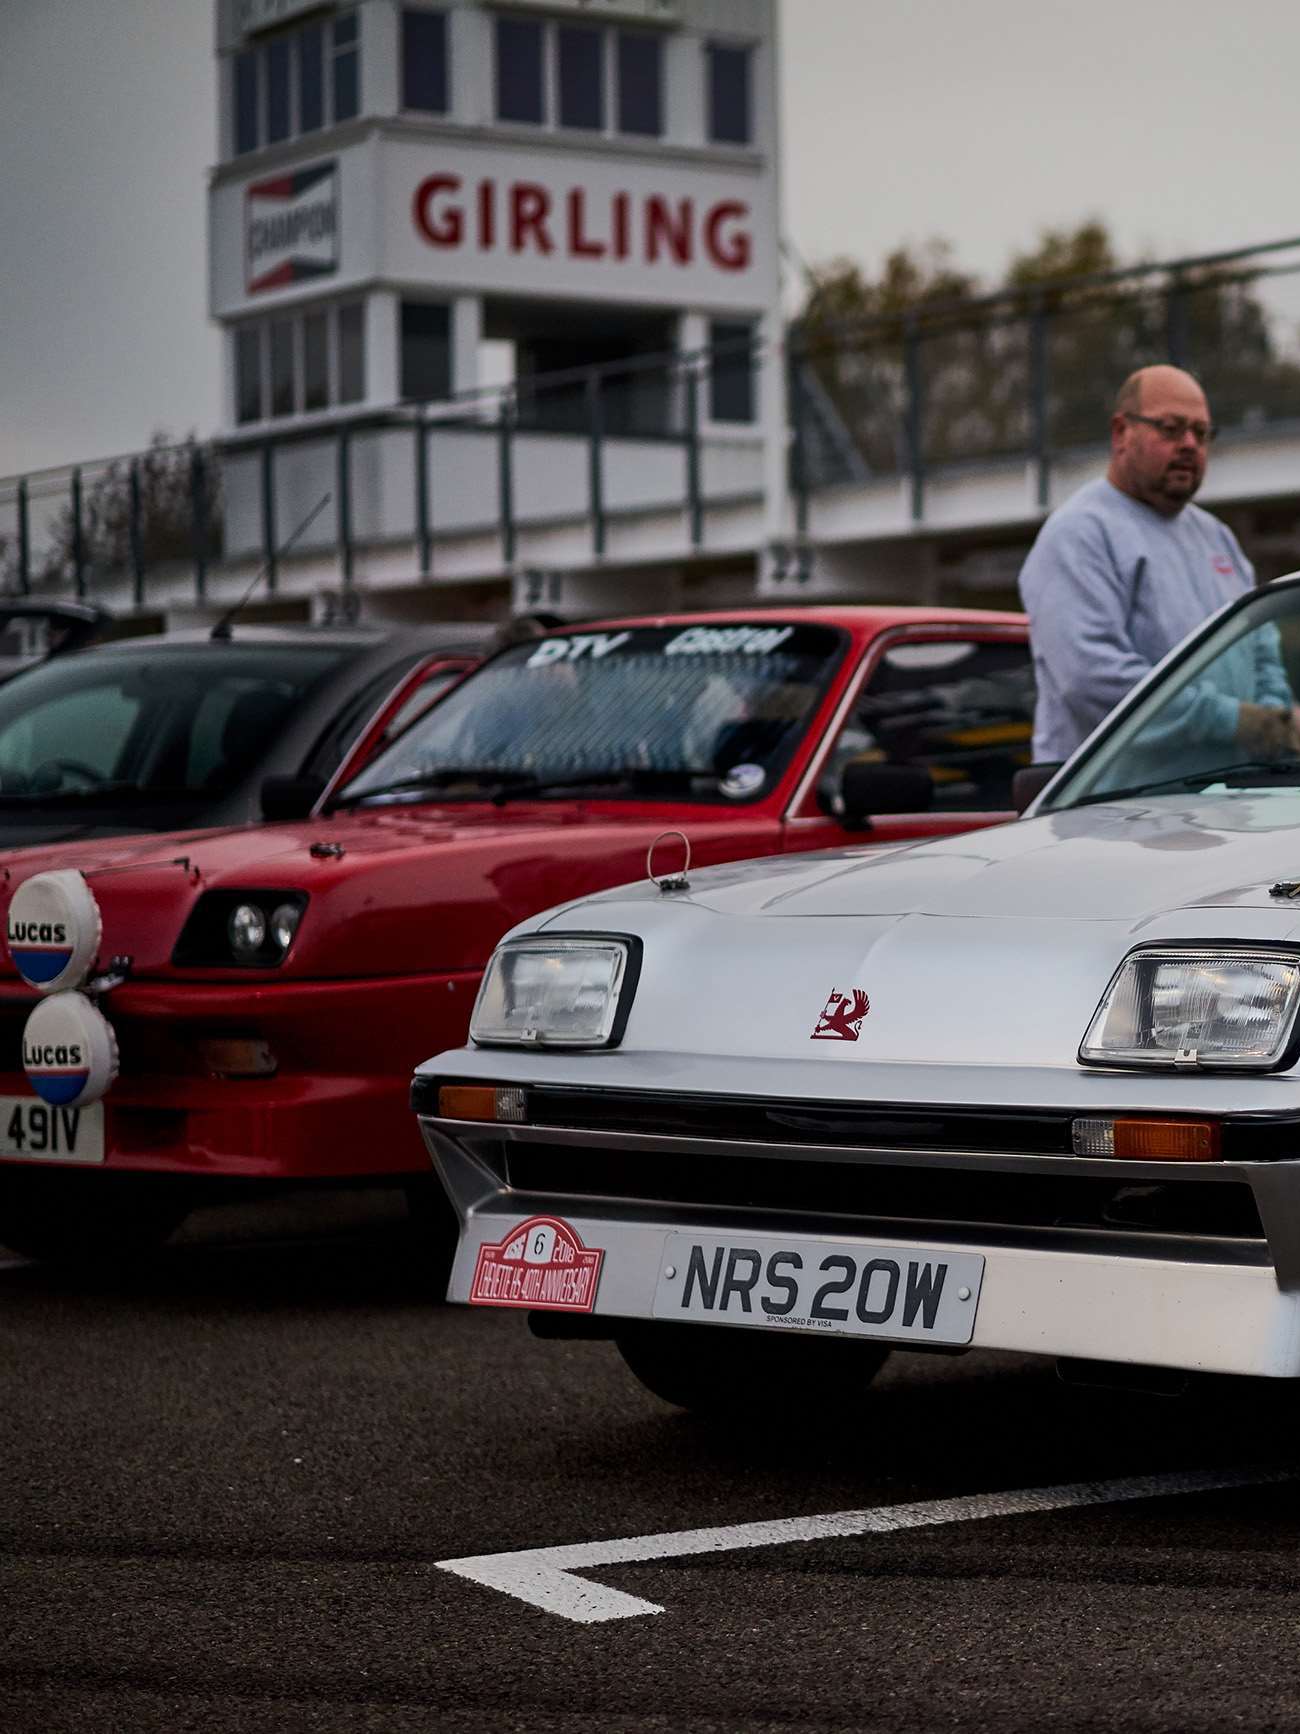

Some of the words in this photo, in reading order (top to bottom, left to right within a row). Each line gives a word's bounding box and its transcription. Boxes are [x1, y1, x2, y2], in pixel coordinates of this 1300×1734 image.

[411, 172, 752, 272] GIRLING
[527, 631, 632, 669] DTV
[8, 918, 66, 943] Lucas
[23, 1038, 81, 1065] Lucas
[534, 1232, 546, 1255] 6
[681, 1245, 803, 1315] NRS
[810, 1255, 948, 1329] 20W
[766, 1315, 806, 1326] SPONSORED
[806, 1319, 816, 1327] BY
[816, 1320, 832, 1328] VISA
